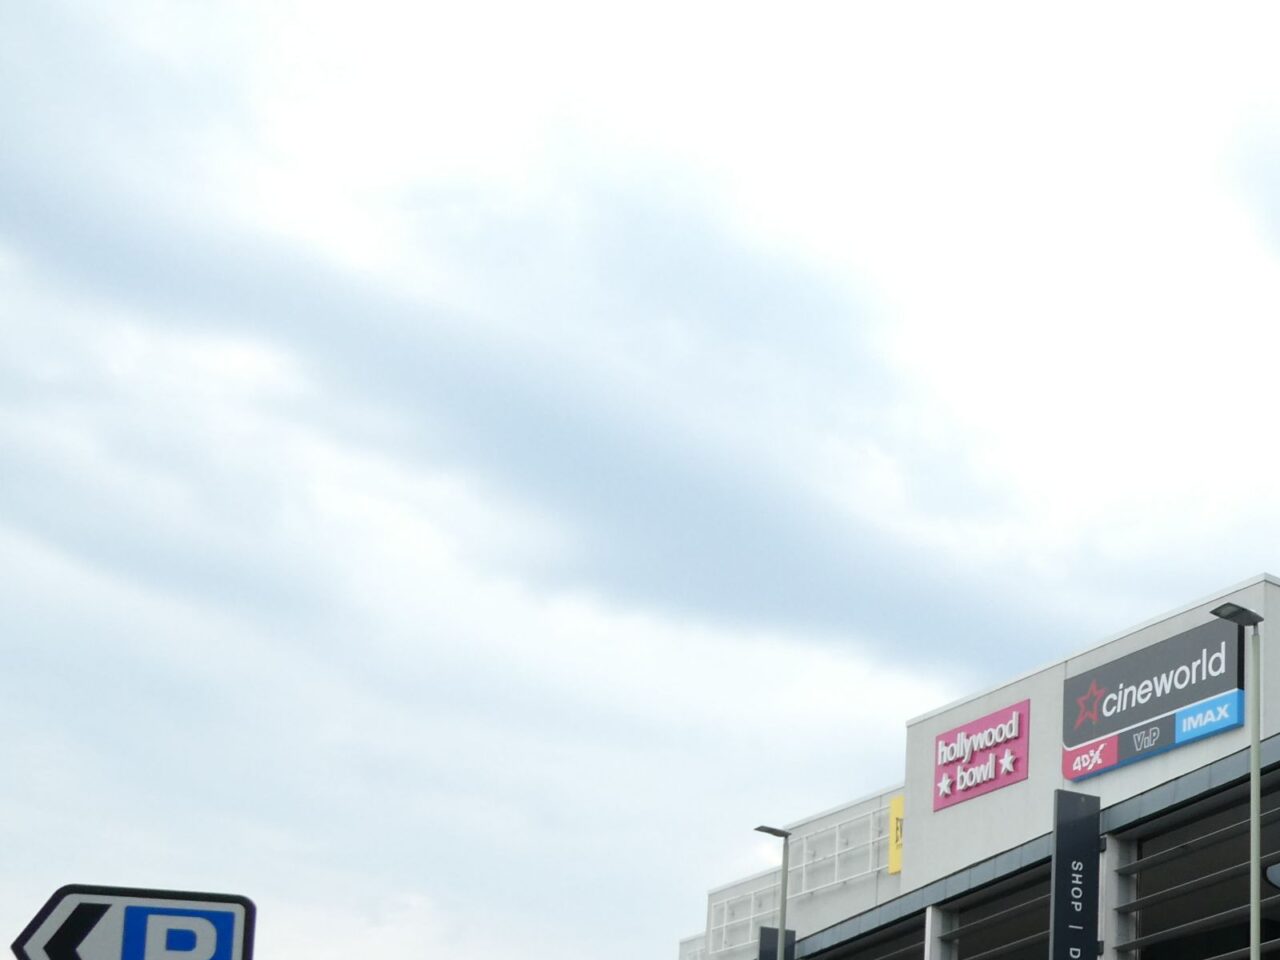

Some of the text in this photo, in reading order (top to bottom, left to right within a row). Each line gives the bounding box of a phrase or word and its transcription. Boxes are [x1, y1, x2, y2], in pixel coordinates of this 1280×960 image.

[1102, 641, 1226, 718] cineworld
[937, 711, 1020, 766] hollywood
[1181, 701, 1232, 733] IMAX
[956, 753, 997, 791] bowl
[1072, 743, 1106, 771] 4DX
[1071, 860, 1083, 912] SHOP
